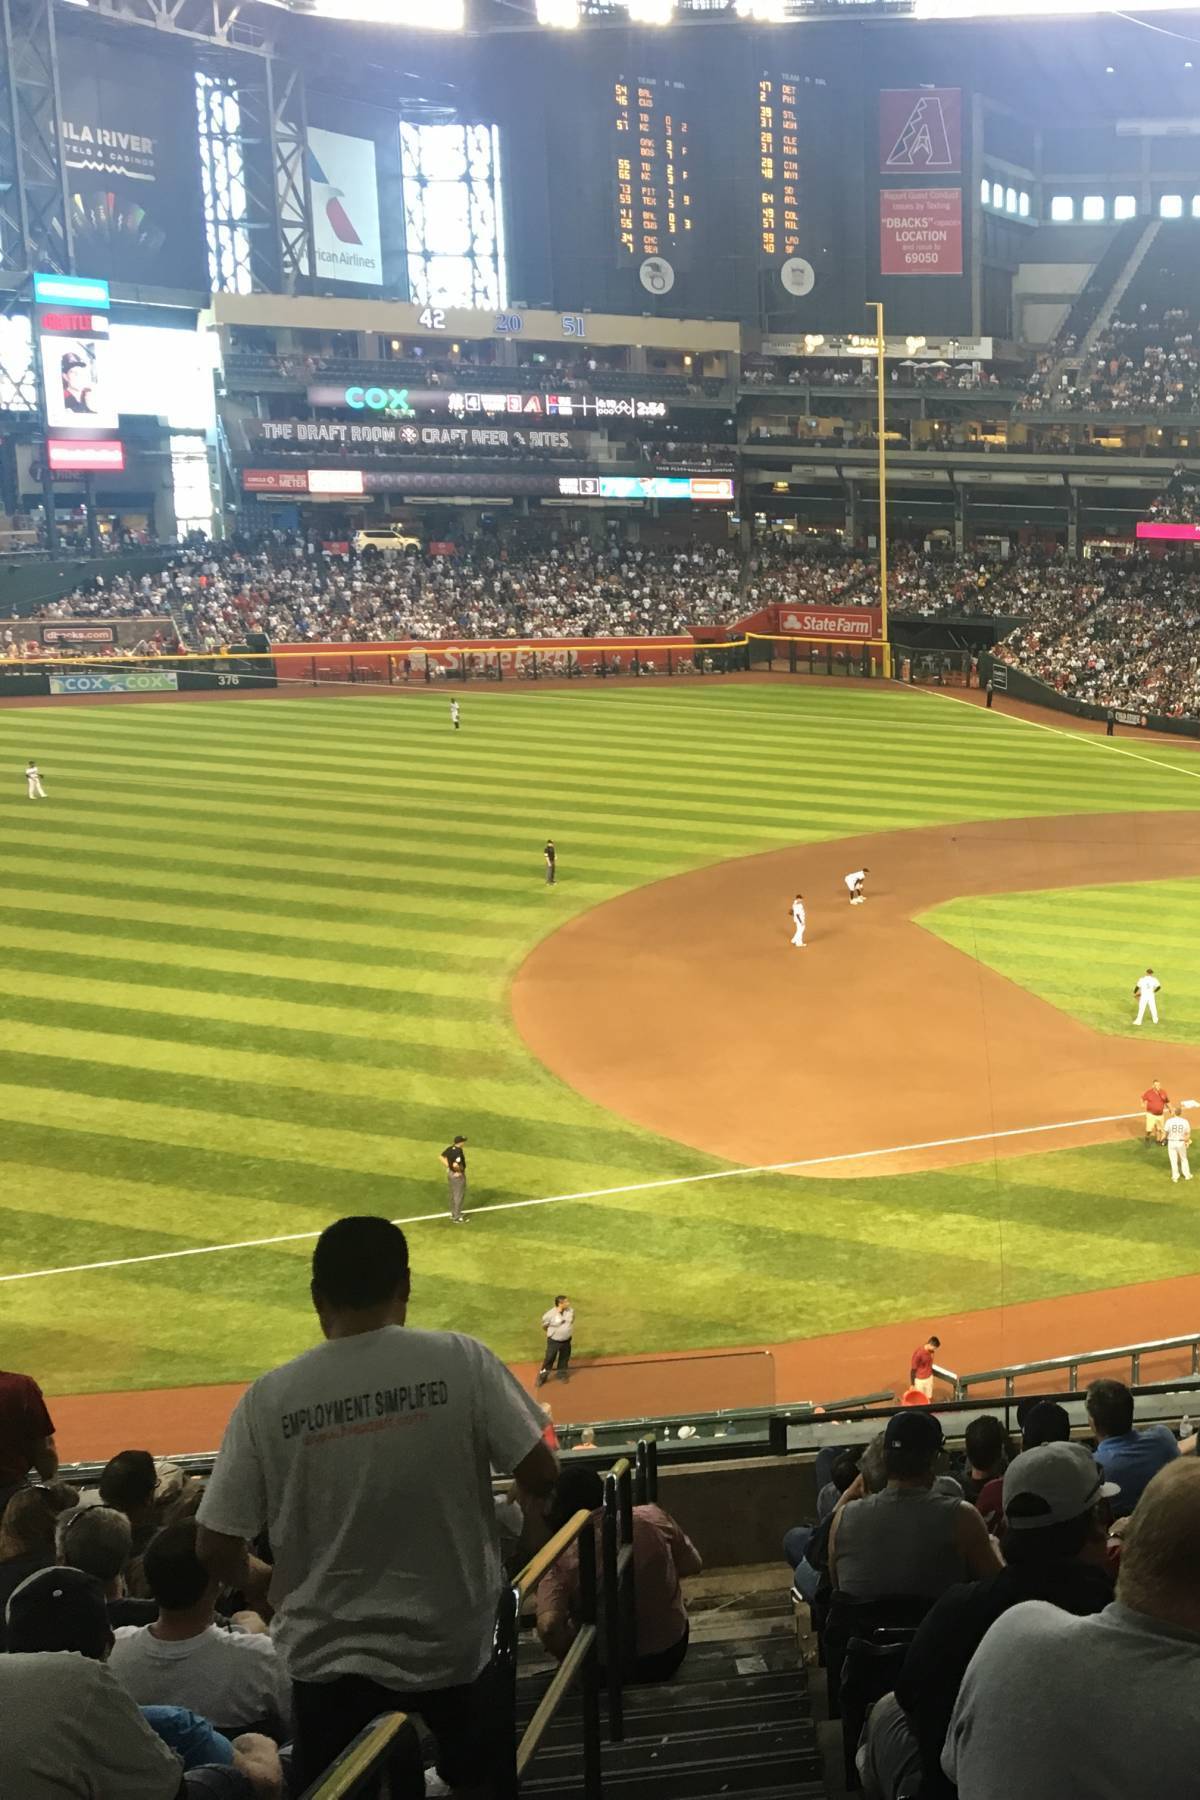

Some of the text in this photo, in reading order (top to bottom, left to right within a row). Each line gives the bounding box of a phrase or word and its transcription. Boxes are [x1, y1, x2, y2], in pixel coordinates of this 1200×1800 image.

[97, 128, 154, 154] RIVER
[784, 136, 797, 145] CLE
[50, 144, 92, 156] TELS
[110, 152, 155, 166] CASINOS
[896, 231, 946, 242] LOCATION
[340, 252, 376, 268] Airlines
[905, 253, 938, 264] 69050
[418, 308, 446, 329] 42
[495, 314, 522, 333] 20
[561, 316, 586, 337] 51
[345, 386, 408, 410] COX
[262, 423, 292, 440] THE
[297, 424, 348, 441] DRAFT
[352, 426, 396, 442] ROOM
[422, 428, 468, 444] CRAFT
[530, 432, 569, 448] BITES
[803, 616, 868, 633] State Farm
[48, 631, 109, 640] dbcks.com
[66, 676, 164, 690] COX COX
[218, 675, 240, 686] 376
[282, 1394, 371, 1439] EMPLOYMENT
[375, 1380, 448, 1416] SIMPLIFIED
